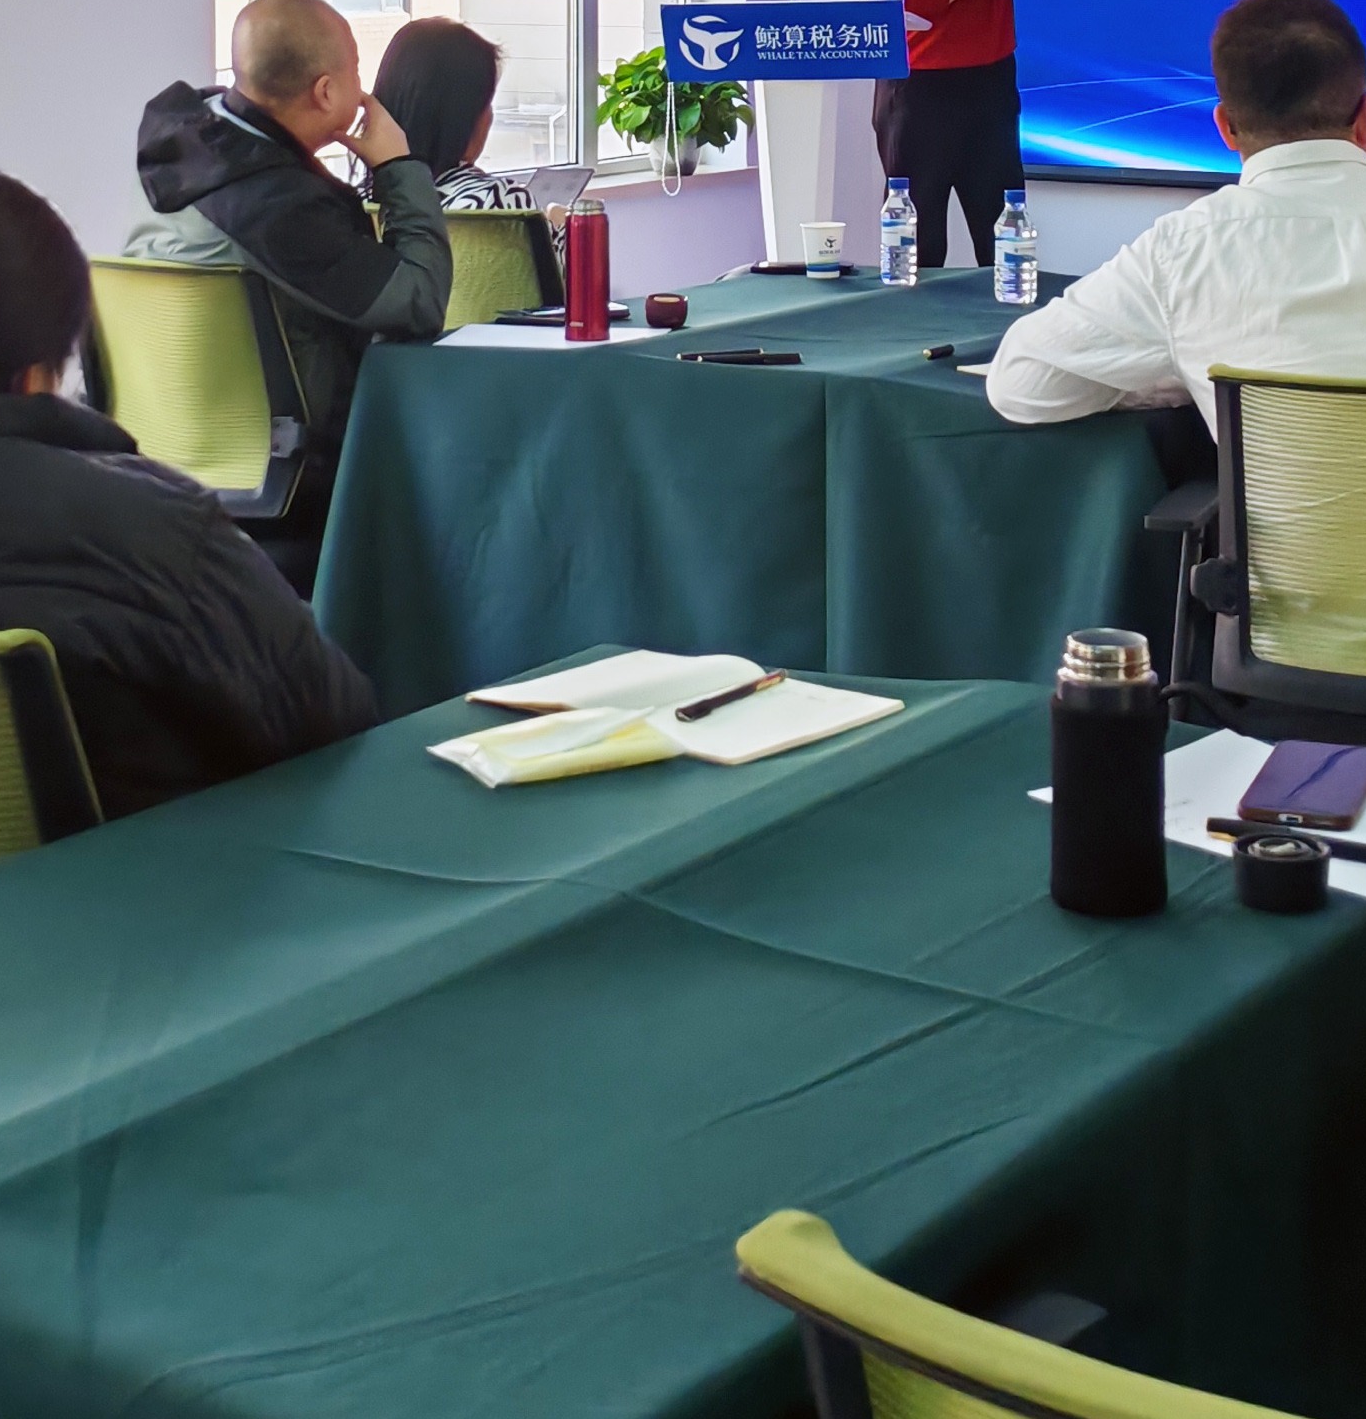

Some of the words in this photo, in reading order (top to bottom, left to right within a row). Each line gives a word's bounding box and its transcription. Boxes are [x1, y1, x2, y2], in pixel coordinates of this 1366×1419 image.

[754, 23, 889, 50] 鲸算税务师
[757, 51, 795, 61] WHALE
[796, 51, 818, 60] TAX
[819, 50, 890, 60] ACCOUNTANT
